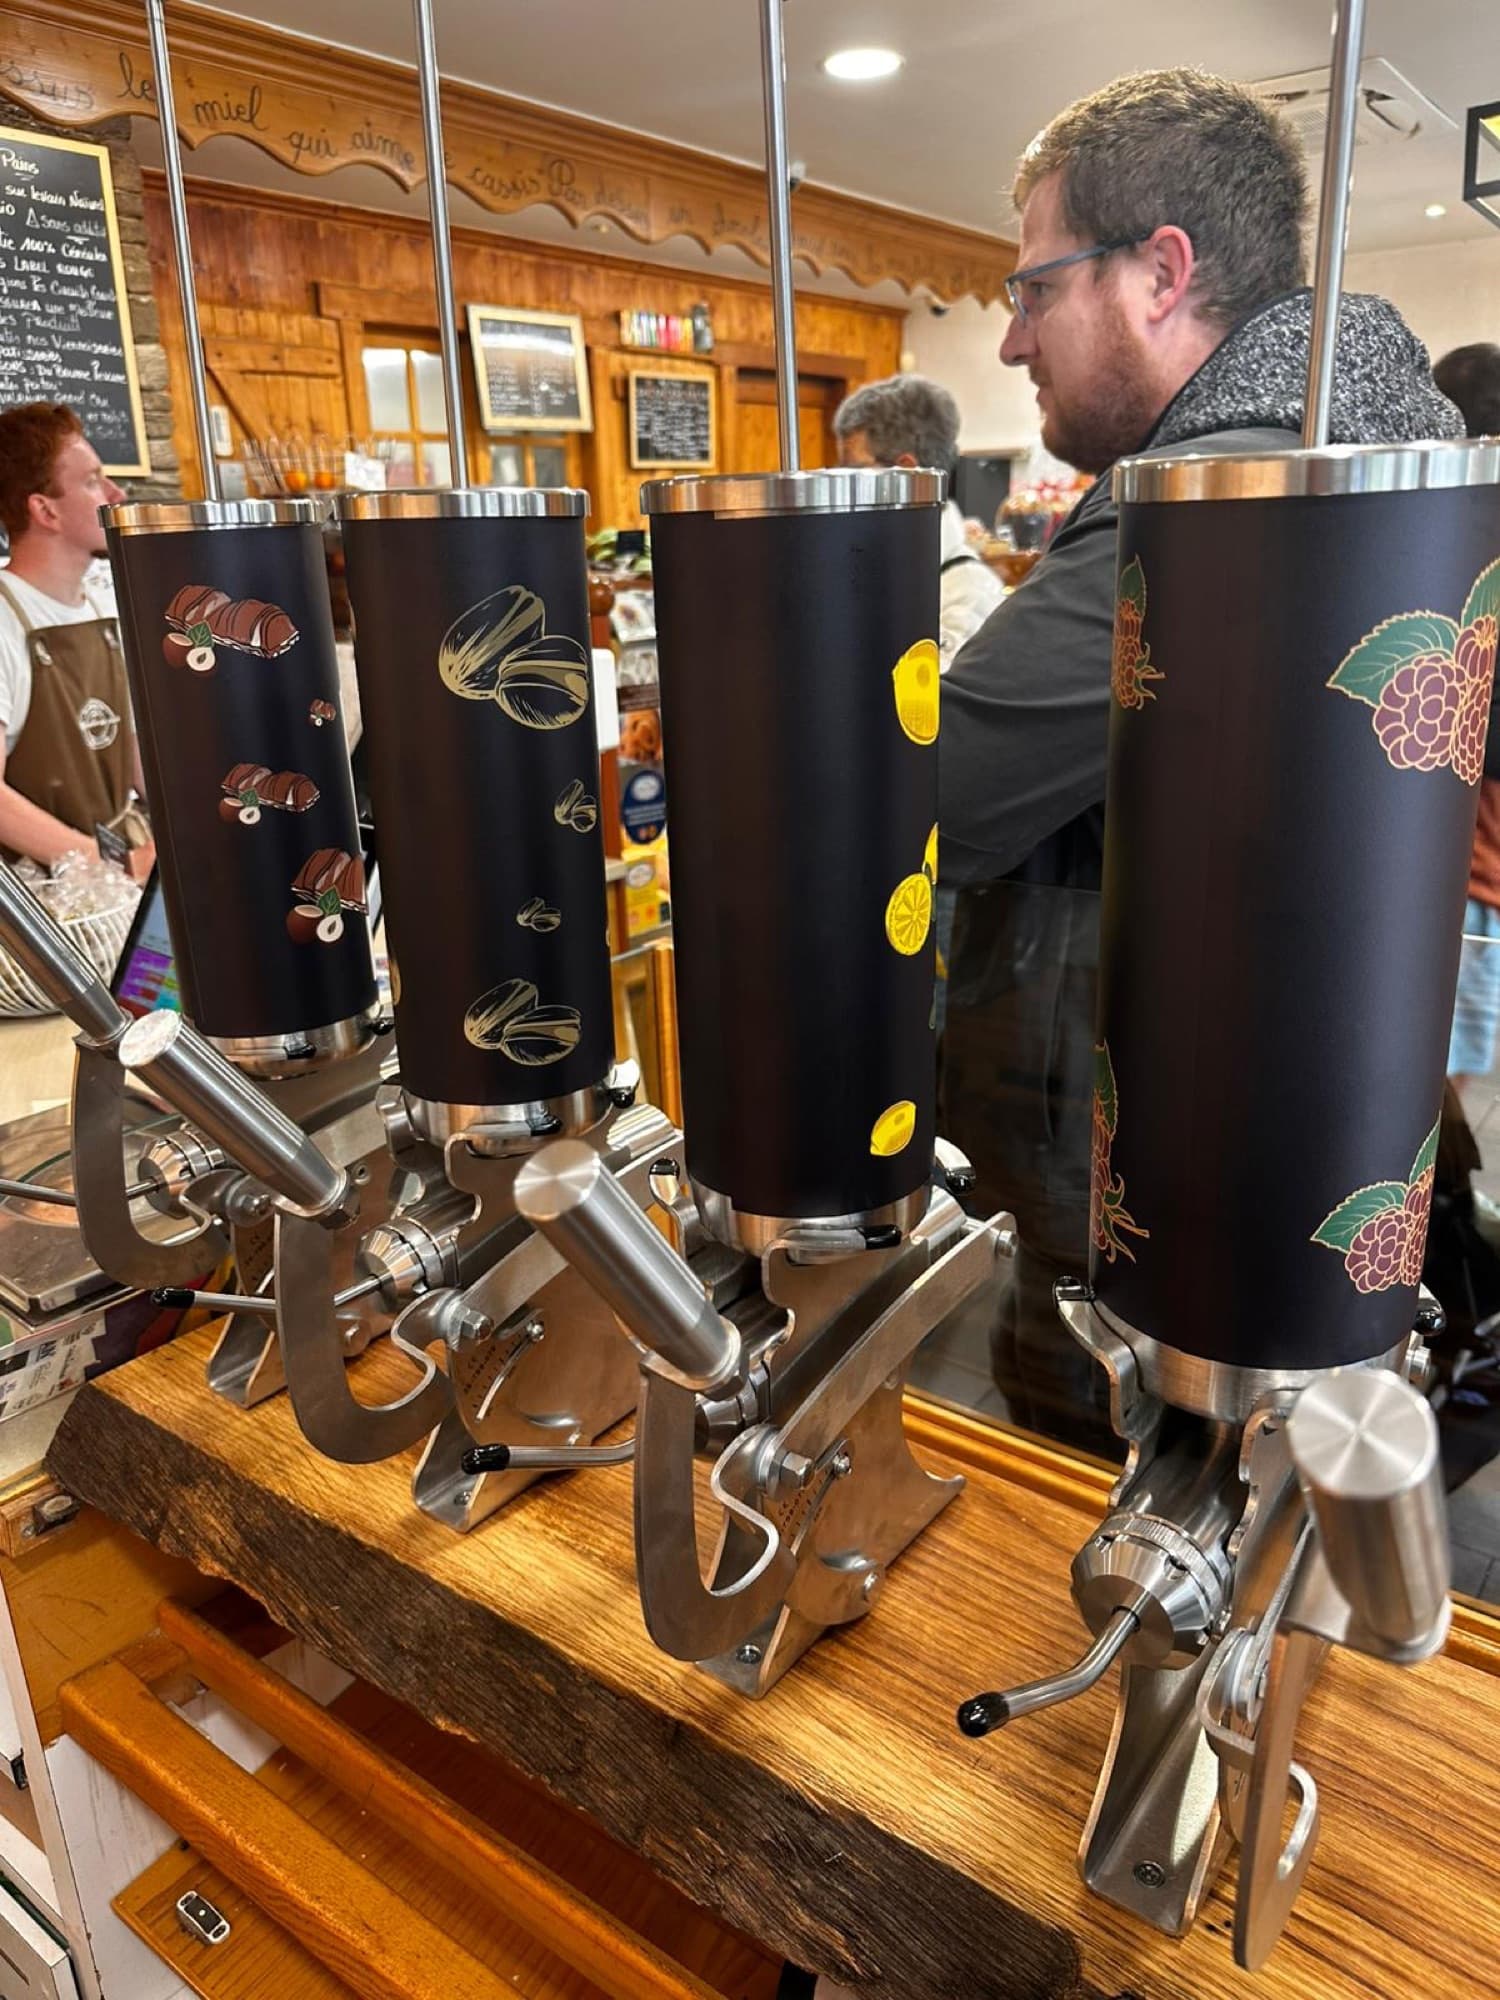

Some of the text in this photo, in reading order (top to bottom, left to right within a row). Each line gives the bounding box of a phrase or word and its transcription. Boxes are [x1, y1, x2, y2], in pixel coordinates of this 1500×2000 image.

[194, 84, 269, 132] miel
[284, 128, 338, 164] qui
[350, 120, 416, 170] aime
